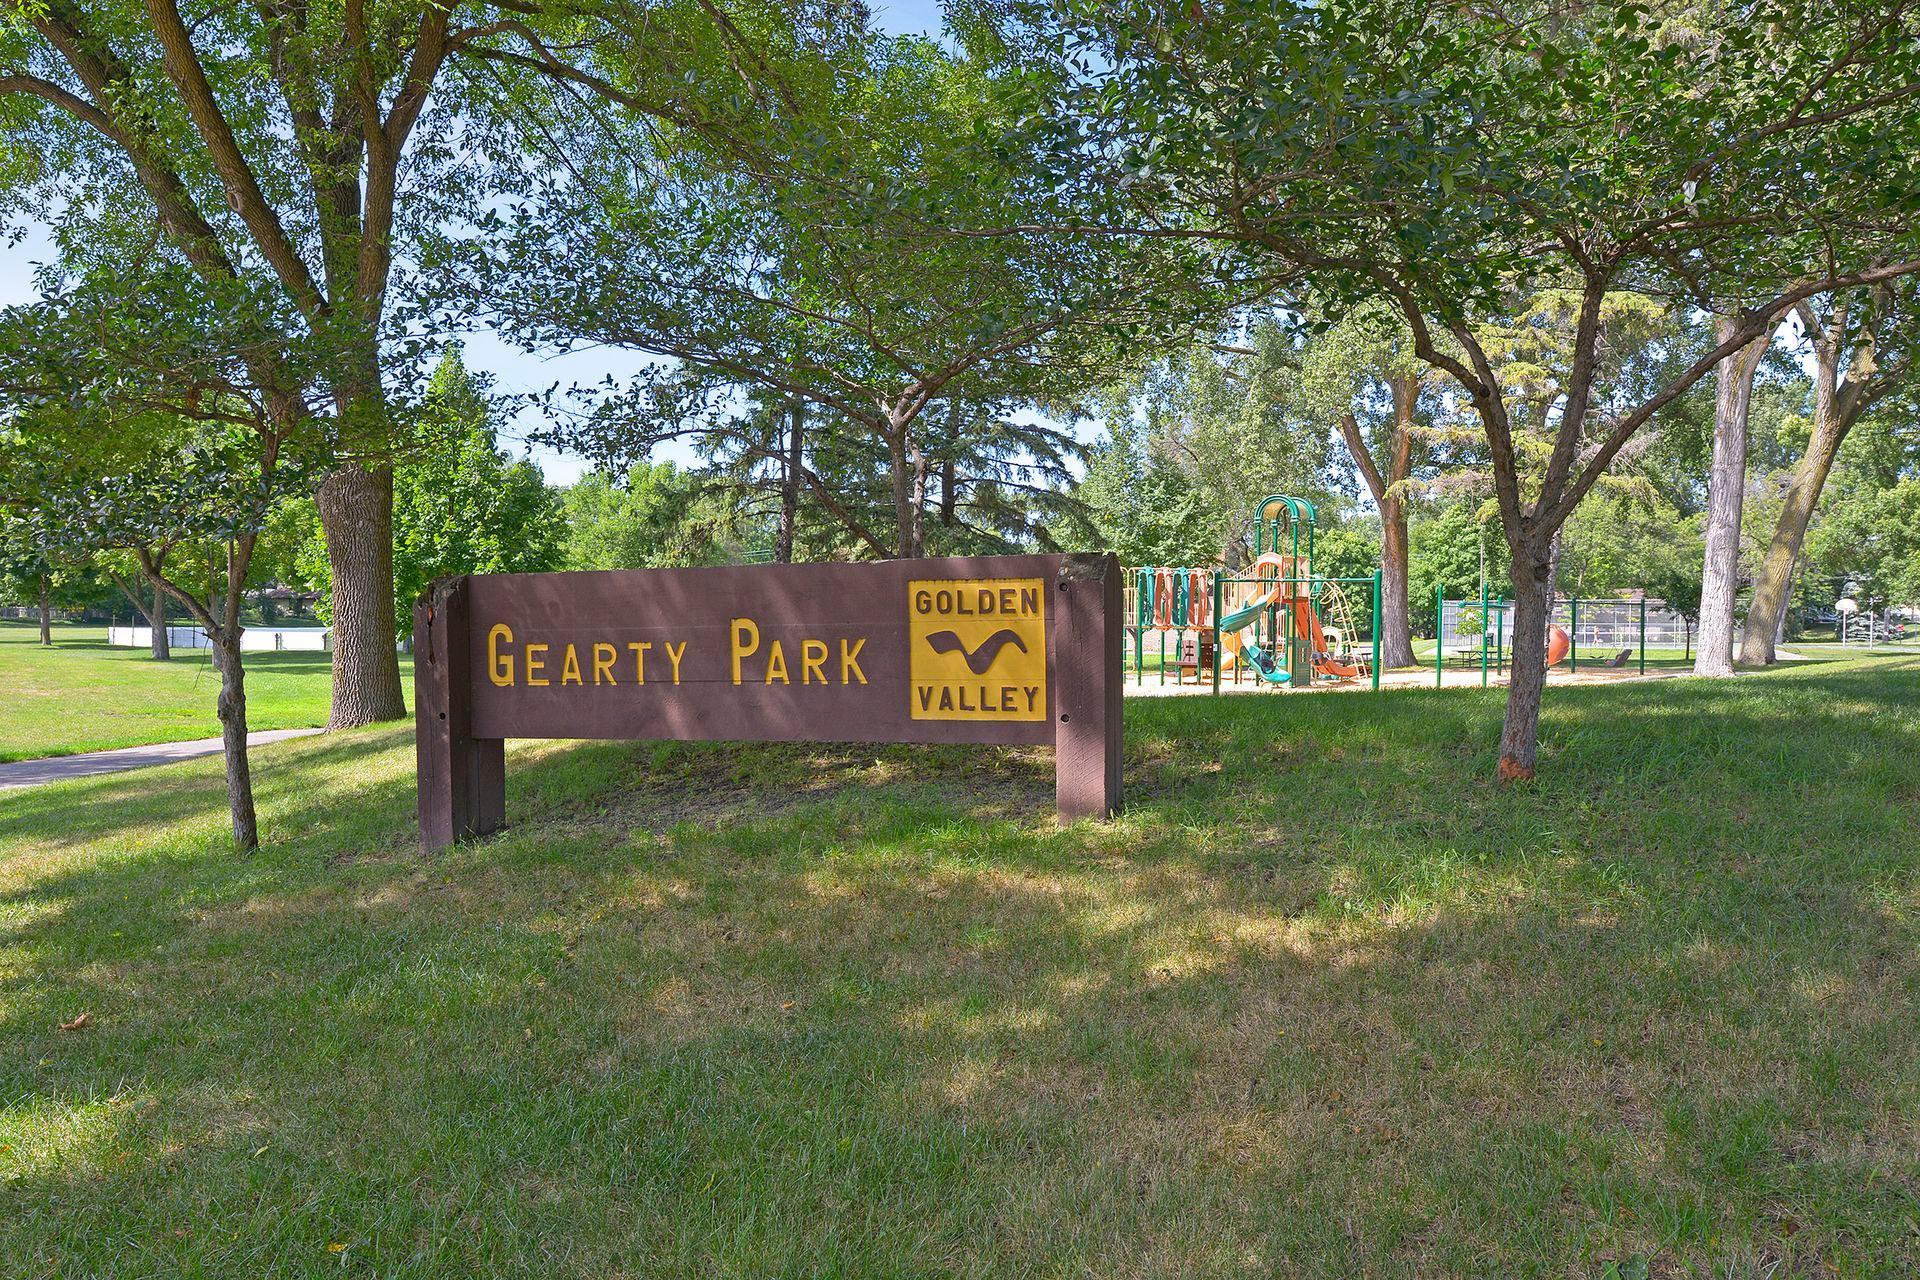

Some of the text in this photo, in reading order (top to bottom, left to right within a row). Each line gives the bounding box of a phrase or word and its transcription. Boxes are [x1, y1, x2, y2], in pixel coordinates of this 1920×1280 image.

[915, 588, 1039, 616] GOLDEN
[487, 617, 869, 687] GEARTY PARK
[917, 685, 1039, 712] VALLEY
